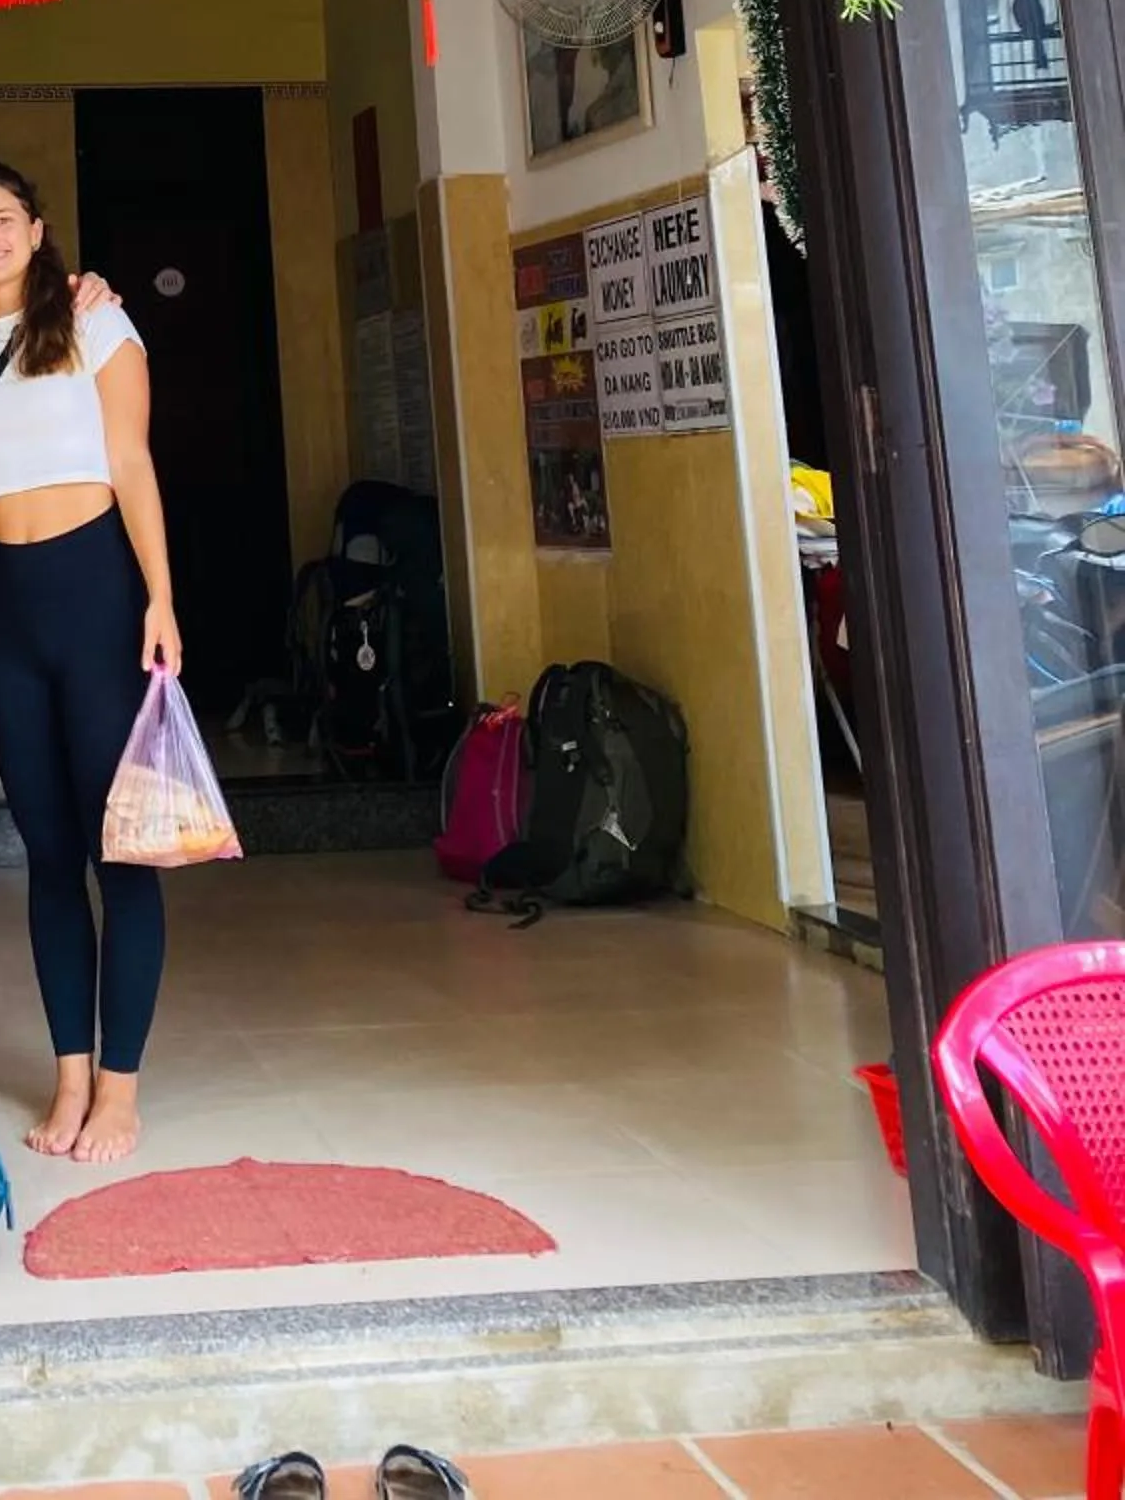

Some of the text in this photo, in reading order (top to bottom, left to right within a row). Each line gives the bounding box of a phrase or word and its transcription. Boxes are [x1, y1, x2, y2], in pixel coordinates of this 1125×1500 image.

[588, 225, 642, 269] EXCHANGE
[652, 207, 700, 253] HERE
[651, 252, 710, 307] LAUNDRY
[596, 334, 654, 362] CAR GO TO
[604, 375, 620, 396] DA
[620, 371, 652, 394] NANG
